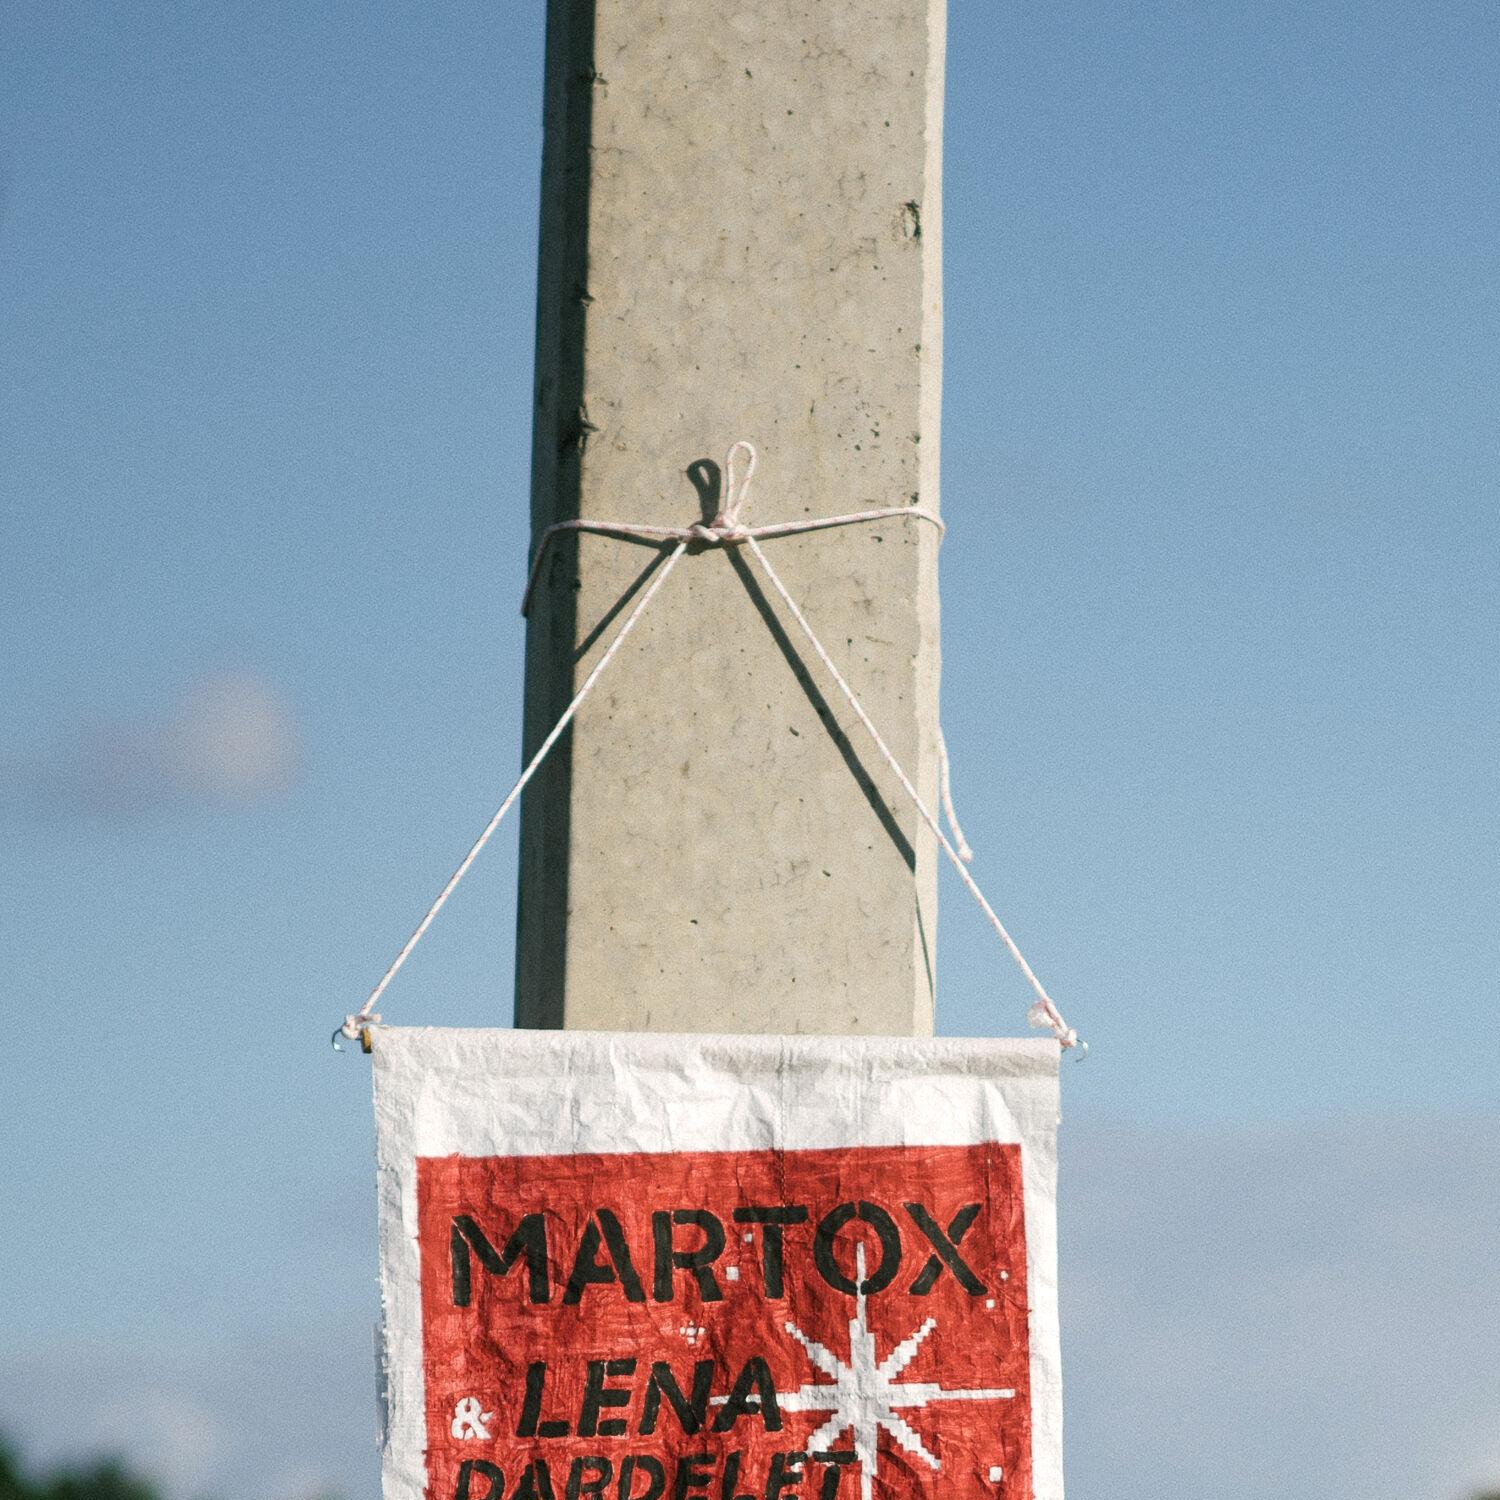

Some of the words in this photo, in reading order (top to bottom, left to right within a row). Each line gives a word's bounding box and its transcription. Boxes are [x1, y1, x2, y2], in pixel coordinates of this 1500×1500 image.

[450, 1200, 988, 1308] MARTOX
[450, 1396, 494, 1440] &
[515, 1356, 784, 1438] LENA
